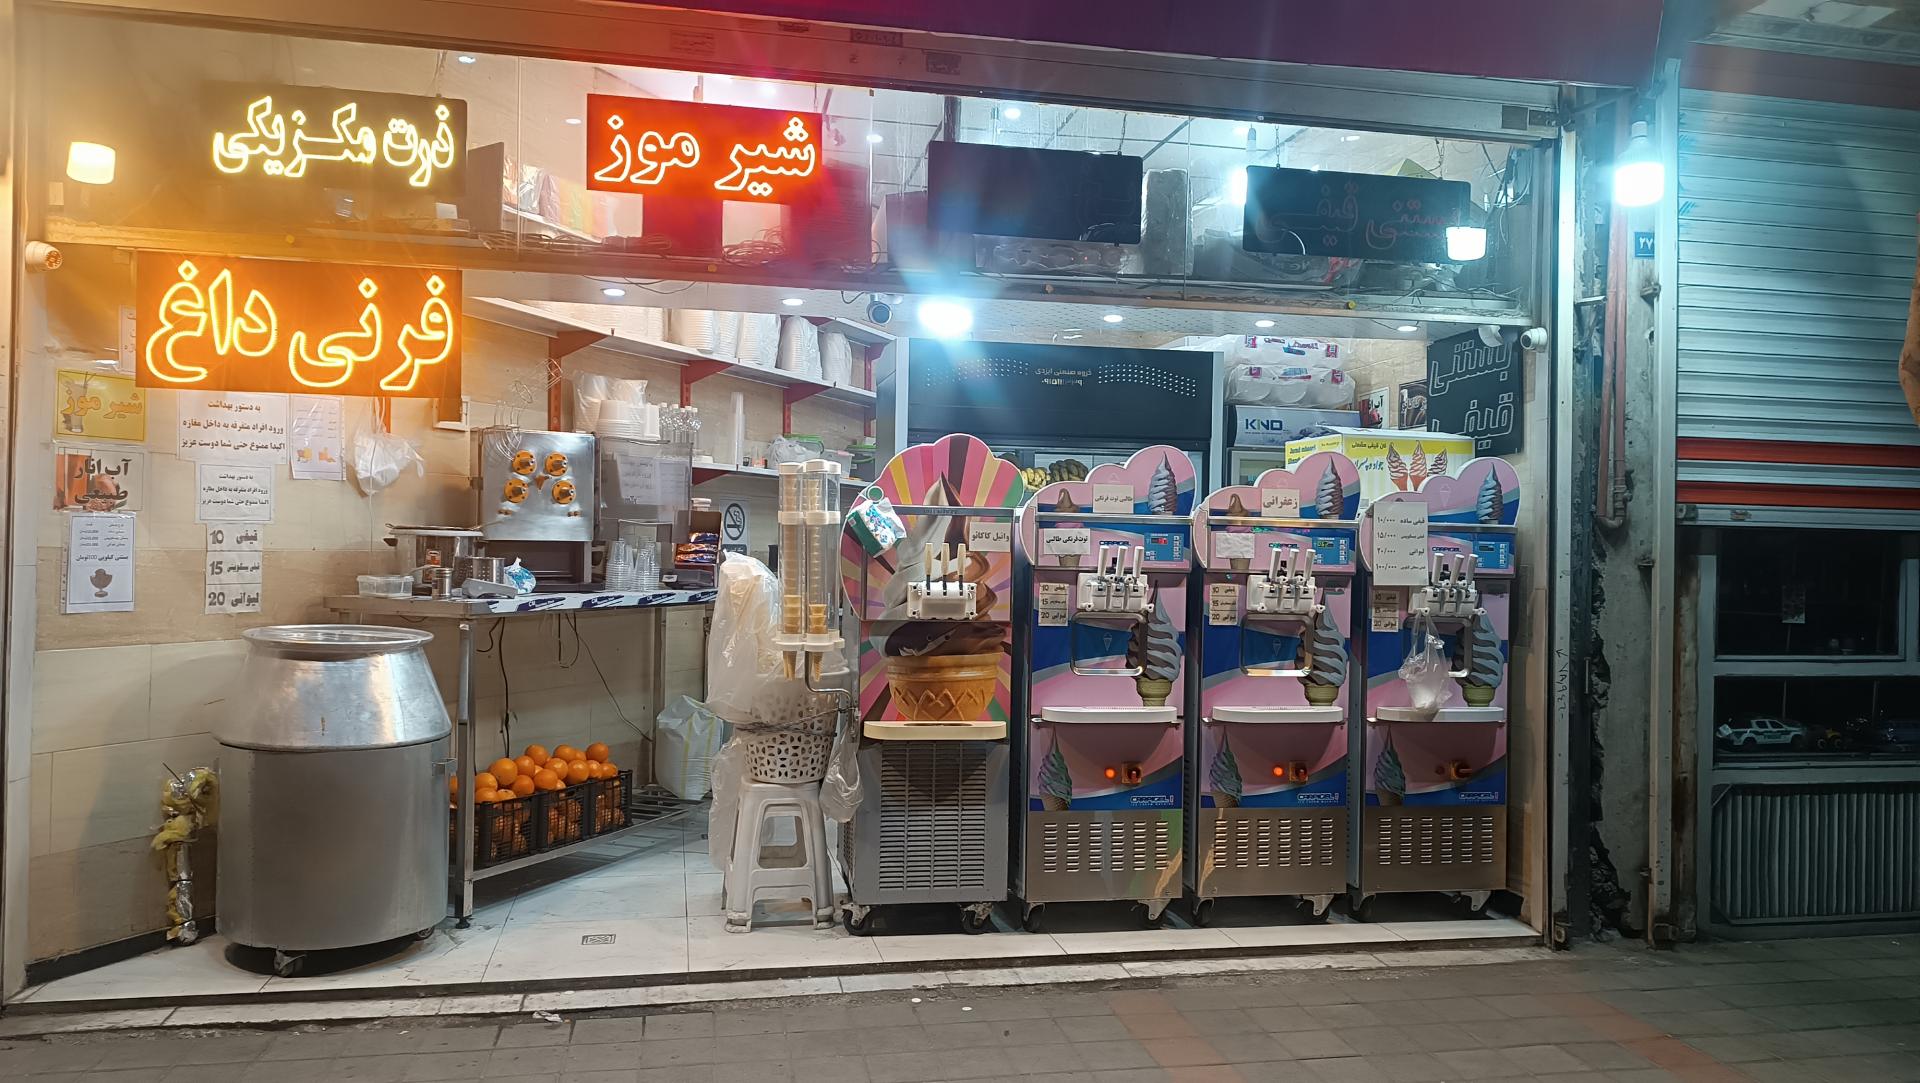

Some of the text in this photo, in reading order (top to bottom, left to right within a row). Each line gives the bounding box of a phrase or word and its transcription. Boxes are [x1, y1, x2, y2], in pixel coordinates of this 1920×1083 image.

[212, 96, 456, 188] ذرت مکزیکی
[594, 115, 816, 198] شیر موز
[145, 260, 456, 391] فرنی داغ
[61, 388, 143, 419] شیر موز
[73, 457, 133, 480] آب انار
[75, 482, 129, 504] طبیعی
[1263, 495, 1298, 510] زعفرانی
[209, 529, 258, 545] قیفی 10
[992, 531, 1010, 542] وانیل
[209, 560, 223, 576] 15
[208, 591, 259, 607] لیوانی 20
[1041, 611, 1050, 619] 20
